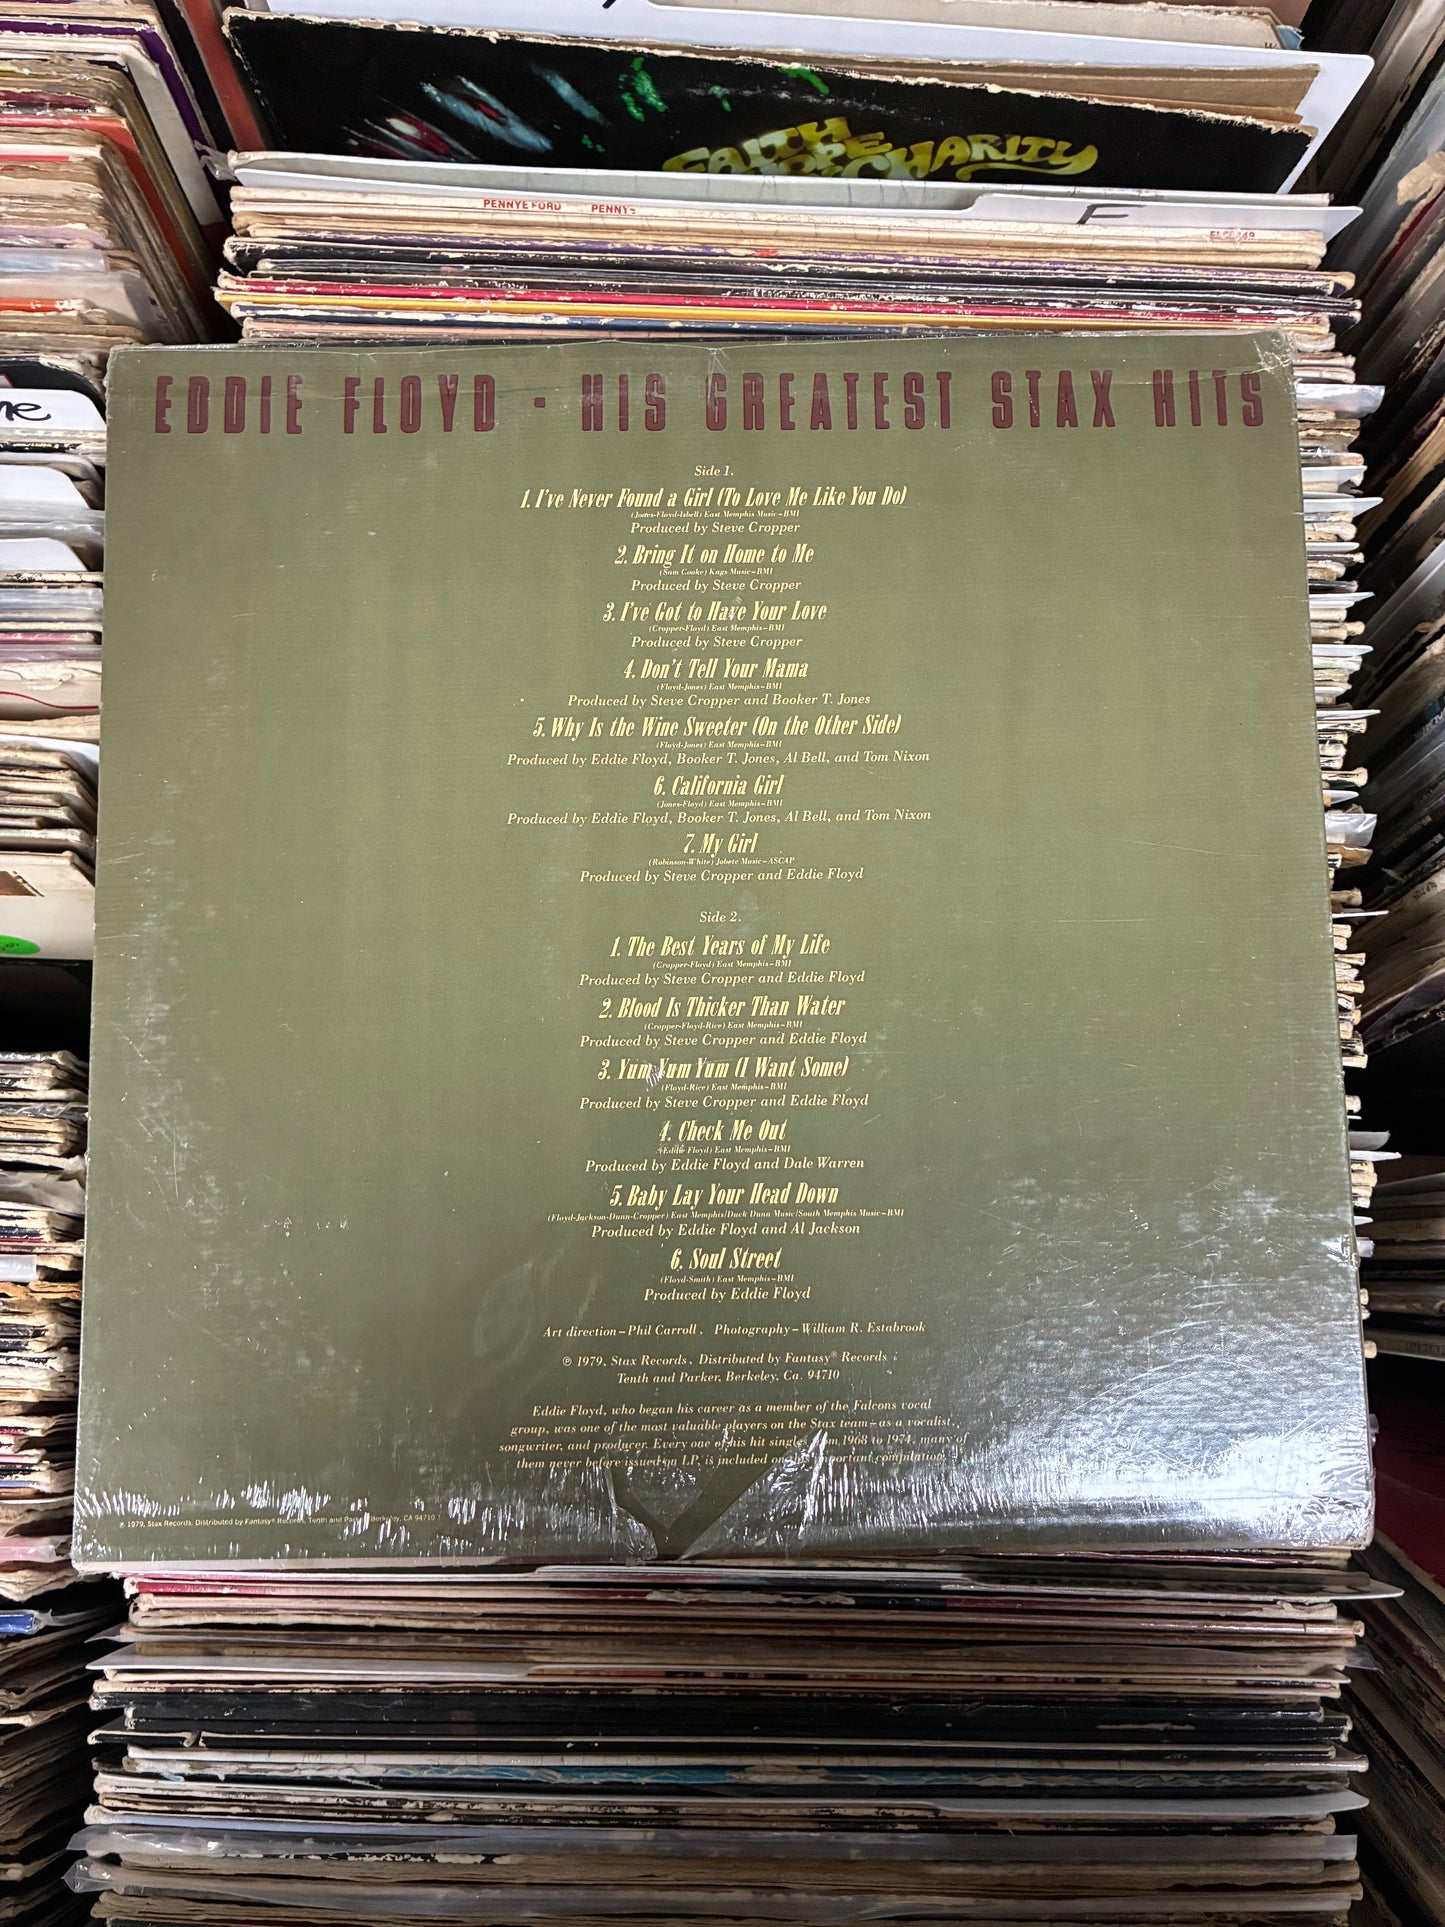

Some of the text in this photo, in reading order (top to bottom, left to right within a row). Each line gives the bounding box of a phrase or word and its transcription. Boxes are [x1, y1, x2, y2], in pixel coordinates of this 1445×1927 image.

[483, 199, 529, 210] PENNYE
[531, 202, 562, 211] FORD
[154, 370, 1264, 434] EDDIE FLOYD HIS GREATEST STAX HITS
[695, 465, 733, 476] Side 1.
[521, 486, 907, 508] 1. I've Never Found a Girl (To Love Me Like You Do)
[631, 521, 800, 535] Produced by Steve Cropper
[614, 544, 814, 568] 2. Bring It on Home to Me
[603, 600, 827, 621] 3. I've Got to Have Your Love
[624, 658, 808, 678] 4. Don't Tell Your Mama
[568, 693, 870, 709] Produced by Steve Cropper and Booker T. Jones
[533, 714, 901, 741] 5. Why Is the Wine Sweeter (On the Other Side)
[507, 750, 929, 767] Produced by Eddie Floyd, Booker T. Jones, Al Bell, and Tom Nixon
[654, 775, 784, 795] 6. California Girl
[684, 833, 758, 859] 7. My Girl
[700, 911, 741, 922] Side 2.
[610, 934, 830, 959] 1. The Best Years of My Life
[599, 995, 846, 1018] 2. Blood Is Thicker Than Water
[598, 1056, 849, 1080] 3. Yum Yum Yum (I Want Some)
[659, 1120, 787, 1141] 4. Check Me Out
[610, 1183, 838, 1211] 5. Baby Lay Your Head Down
[671, 1248, 782, 1271] 6. Soul Street
[617, 1369, 839, 1384] Tenth and Parker, Berkeley, Ca. 94710
[533, 1405, 566, 1416] Eddie
[612, 1404, 635, 1415] who
[639, 1403, 673, 1417] began
[677, 1403, 693, 1413] his
[737, 1405, 751, 1413] as
[766, 1401, 812, 1412] member
[816, 1400, 829, 1414] of
[831, 1400, 848, 1411] the
[853, 1399, 897, 1411] Falcons
[902, 1399, 931, 1410] vocal
